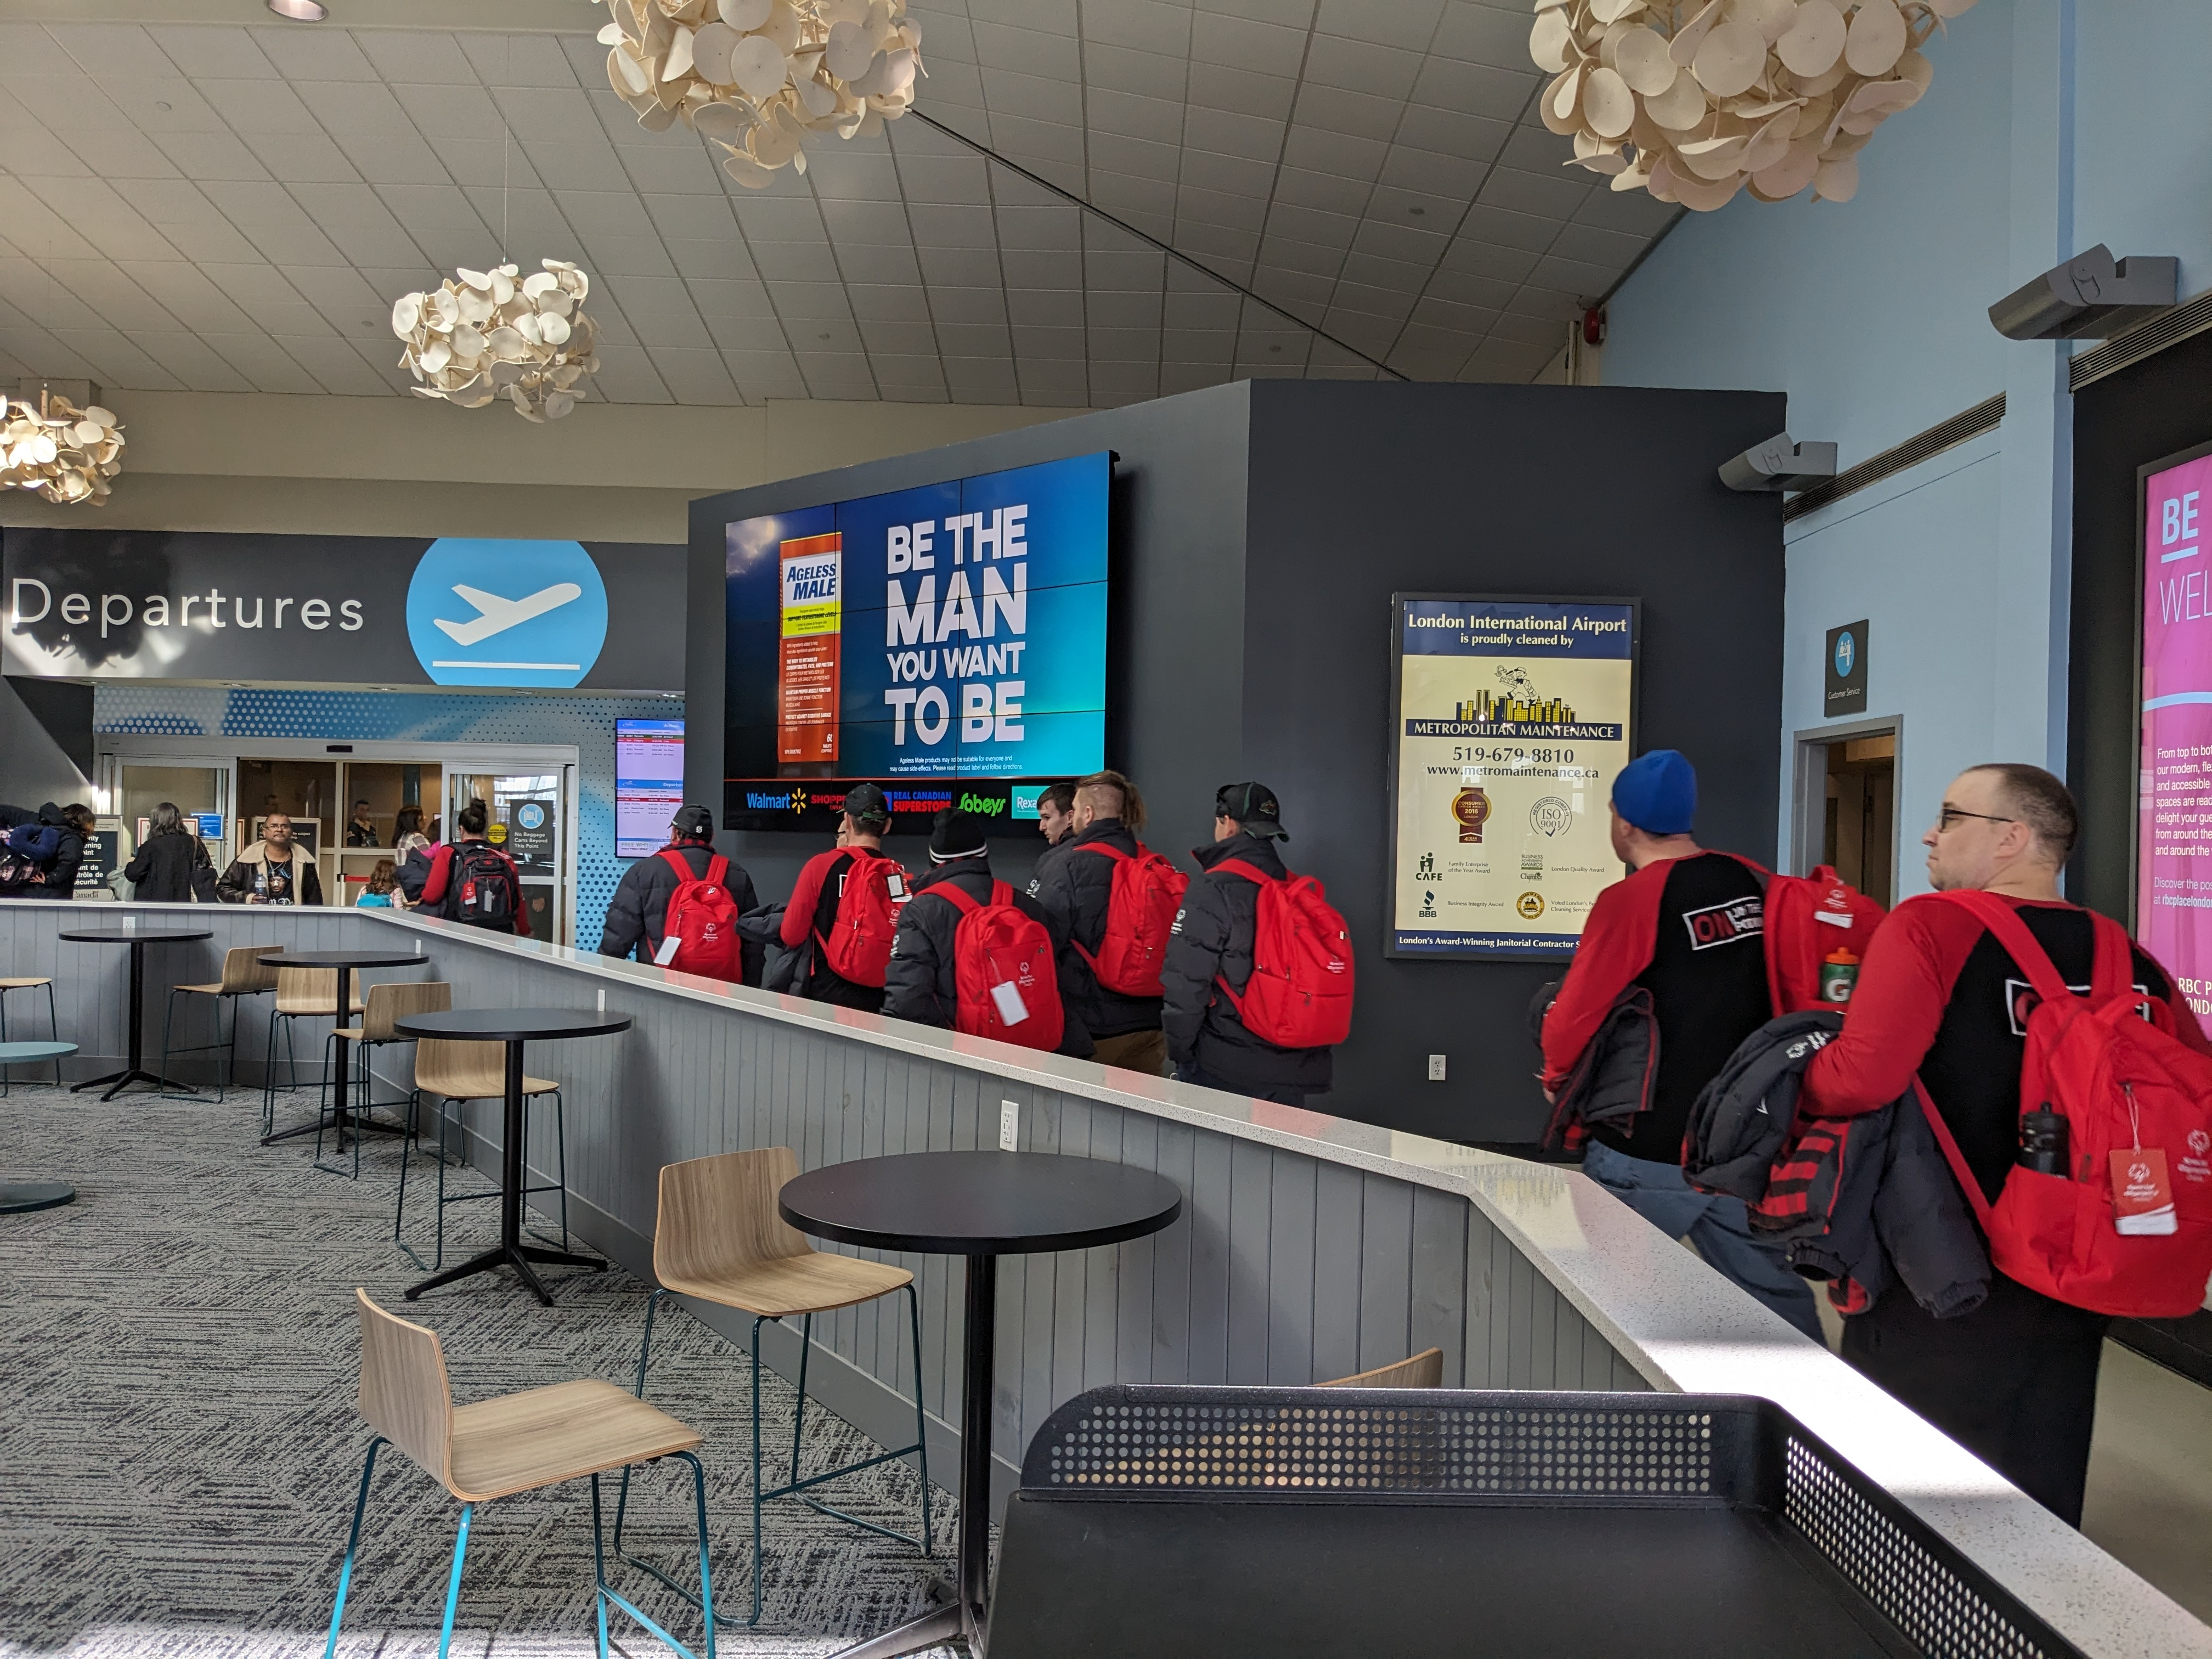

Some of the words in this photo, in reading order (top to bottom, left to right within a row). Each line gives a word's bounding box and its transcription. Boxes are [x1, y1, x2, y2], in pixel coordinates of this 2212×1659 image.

[2162, 490, 2199, 546] BE
[887, 520, 935, 575] BE
[945, 504, 1028, 565] THE
[787, 563, 837, 583] AGELESS
[793, 578, 837, 601] MALE
[12, 577, 364, 639] Departures
[886, 562, 1027, 647] MAN
[1408, 614, 1465, 629] London
[1470, 615, 1567, 631] International
[1571, 616, 1627, 635] Airport
[1460, 633, 1469, 644] is
[1471, 633, 1514, 646] proudly
[1516, 634, 1558, 646] cleaned
[1560, 635, 1574, 648] by
[887, 649, 937, 683] YOU
[943, 641, 1026, 679] WANT
[1827, 691, 1846, 700] Customer
[1846, 687, 1860, 696] Service
[884, 686, 950, 746] TO
[961, 680, 1026, 744] BE
[1414, 722, 1516, 737] METROPOLITAN
[1520, 724, 1614, 738] MAINTENANCE
[1452, 746, 1575, 764] 519-679-8810
[2157, 748, 2175, 759] From
[2177, 747, 2190, 760] top
[2191, 746, 2199, 757] to
[1426, 765, 1599, 779] www.metromaintenance.ca
[2157, 766, 2169, 775] our
[2170, 762, 2200, 775] modern,
[2157, 780, 2170, 791] and
[2171, 778, 2210, 791] accessible
[747, 793, 791, 809] Walmart
[894, 791, 911, 800] REAL
[913, 791, 952, 800] CANADIAN
[1017, 796, 1037, 810] Rexa
[958, 793, 1006, 817] Sobeys
[1532, 798, 1554, 816] REGISTERED
[1555, 799, 1570, 817] COMPANY
[2156, 797, 2181, 810] spaces
[2183, 797, 2195, 806] are
[1542, 809, 1561, 820] ISO
[2155, 812, 2180, 826] delight
[2181, 814, 2198, 826] your
[2155, 828, 2171, 839] from
[2173, 828, 2198, 839] around
[2200, 828, 2212, 839] the
[2155, 845, 2168, 855] and
[2170, 845, 2195, 856] around
[2197, 845, 2210, 856] the
[1415, 872, 1443, 881] CAFE
[2154, 877, 2185, 889] Discover
[2186, 878, 2198, 889] the
[2154, 895, 2160, 905] at
[1399, 936, 1433, 945] London's
[1435, 938, 1495, 948] Award-Winning
[1497, 939, 1531, 948] Janitorial
[1532, 940, 1574, 949] Contractor
[1826, 979, 1852, 1002] G
[2178, 977, 2201, 995] RBC
